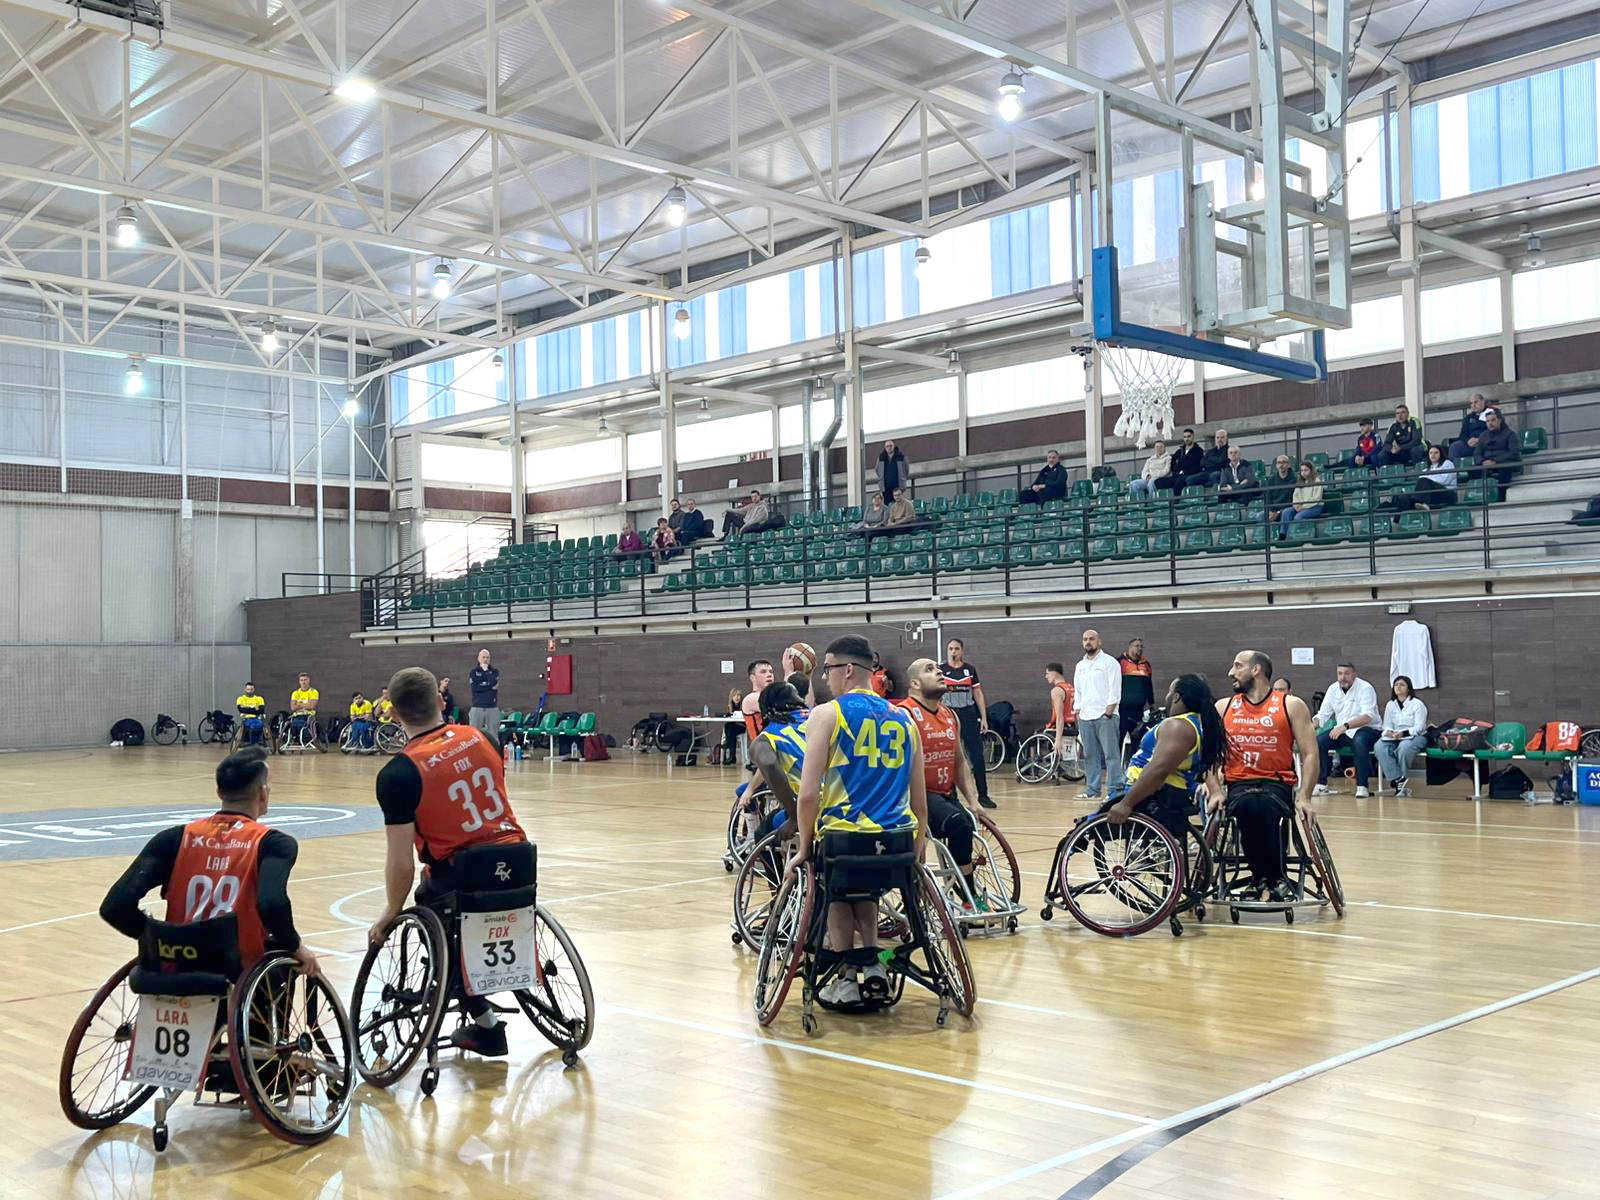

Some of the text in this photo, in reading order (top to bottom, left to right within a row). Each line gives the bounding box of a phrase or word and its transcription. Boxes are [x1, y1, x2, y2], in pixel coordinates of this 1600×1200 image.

[853, 718, 906, 769] 43
[453, 756, 473, 774] FOX
[937, 766, 949, 785] 55
[448, 767, 504, 833] 33
[488, 926, 510, 940] FOX
[482, 939, 517, 968] 33
[477, 974, 531, 991] gaviota
[155, 1008, 189, 1026] LARA
[154, 1026, 190, 1058] 08
[136, 1065, 193, 1084] gaviota
